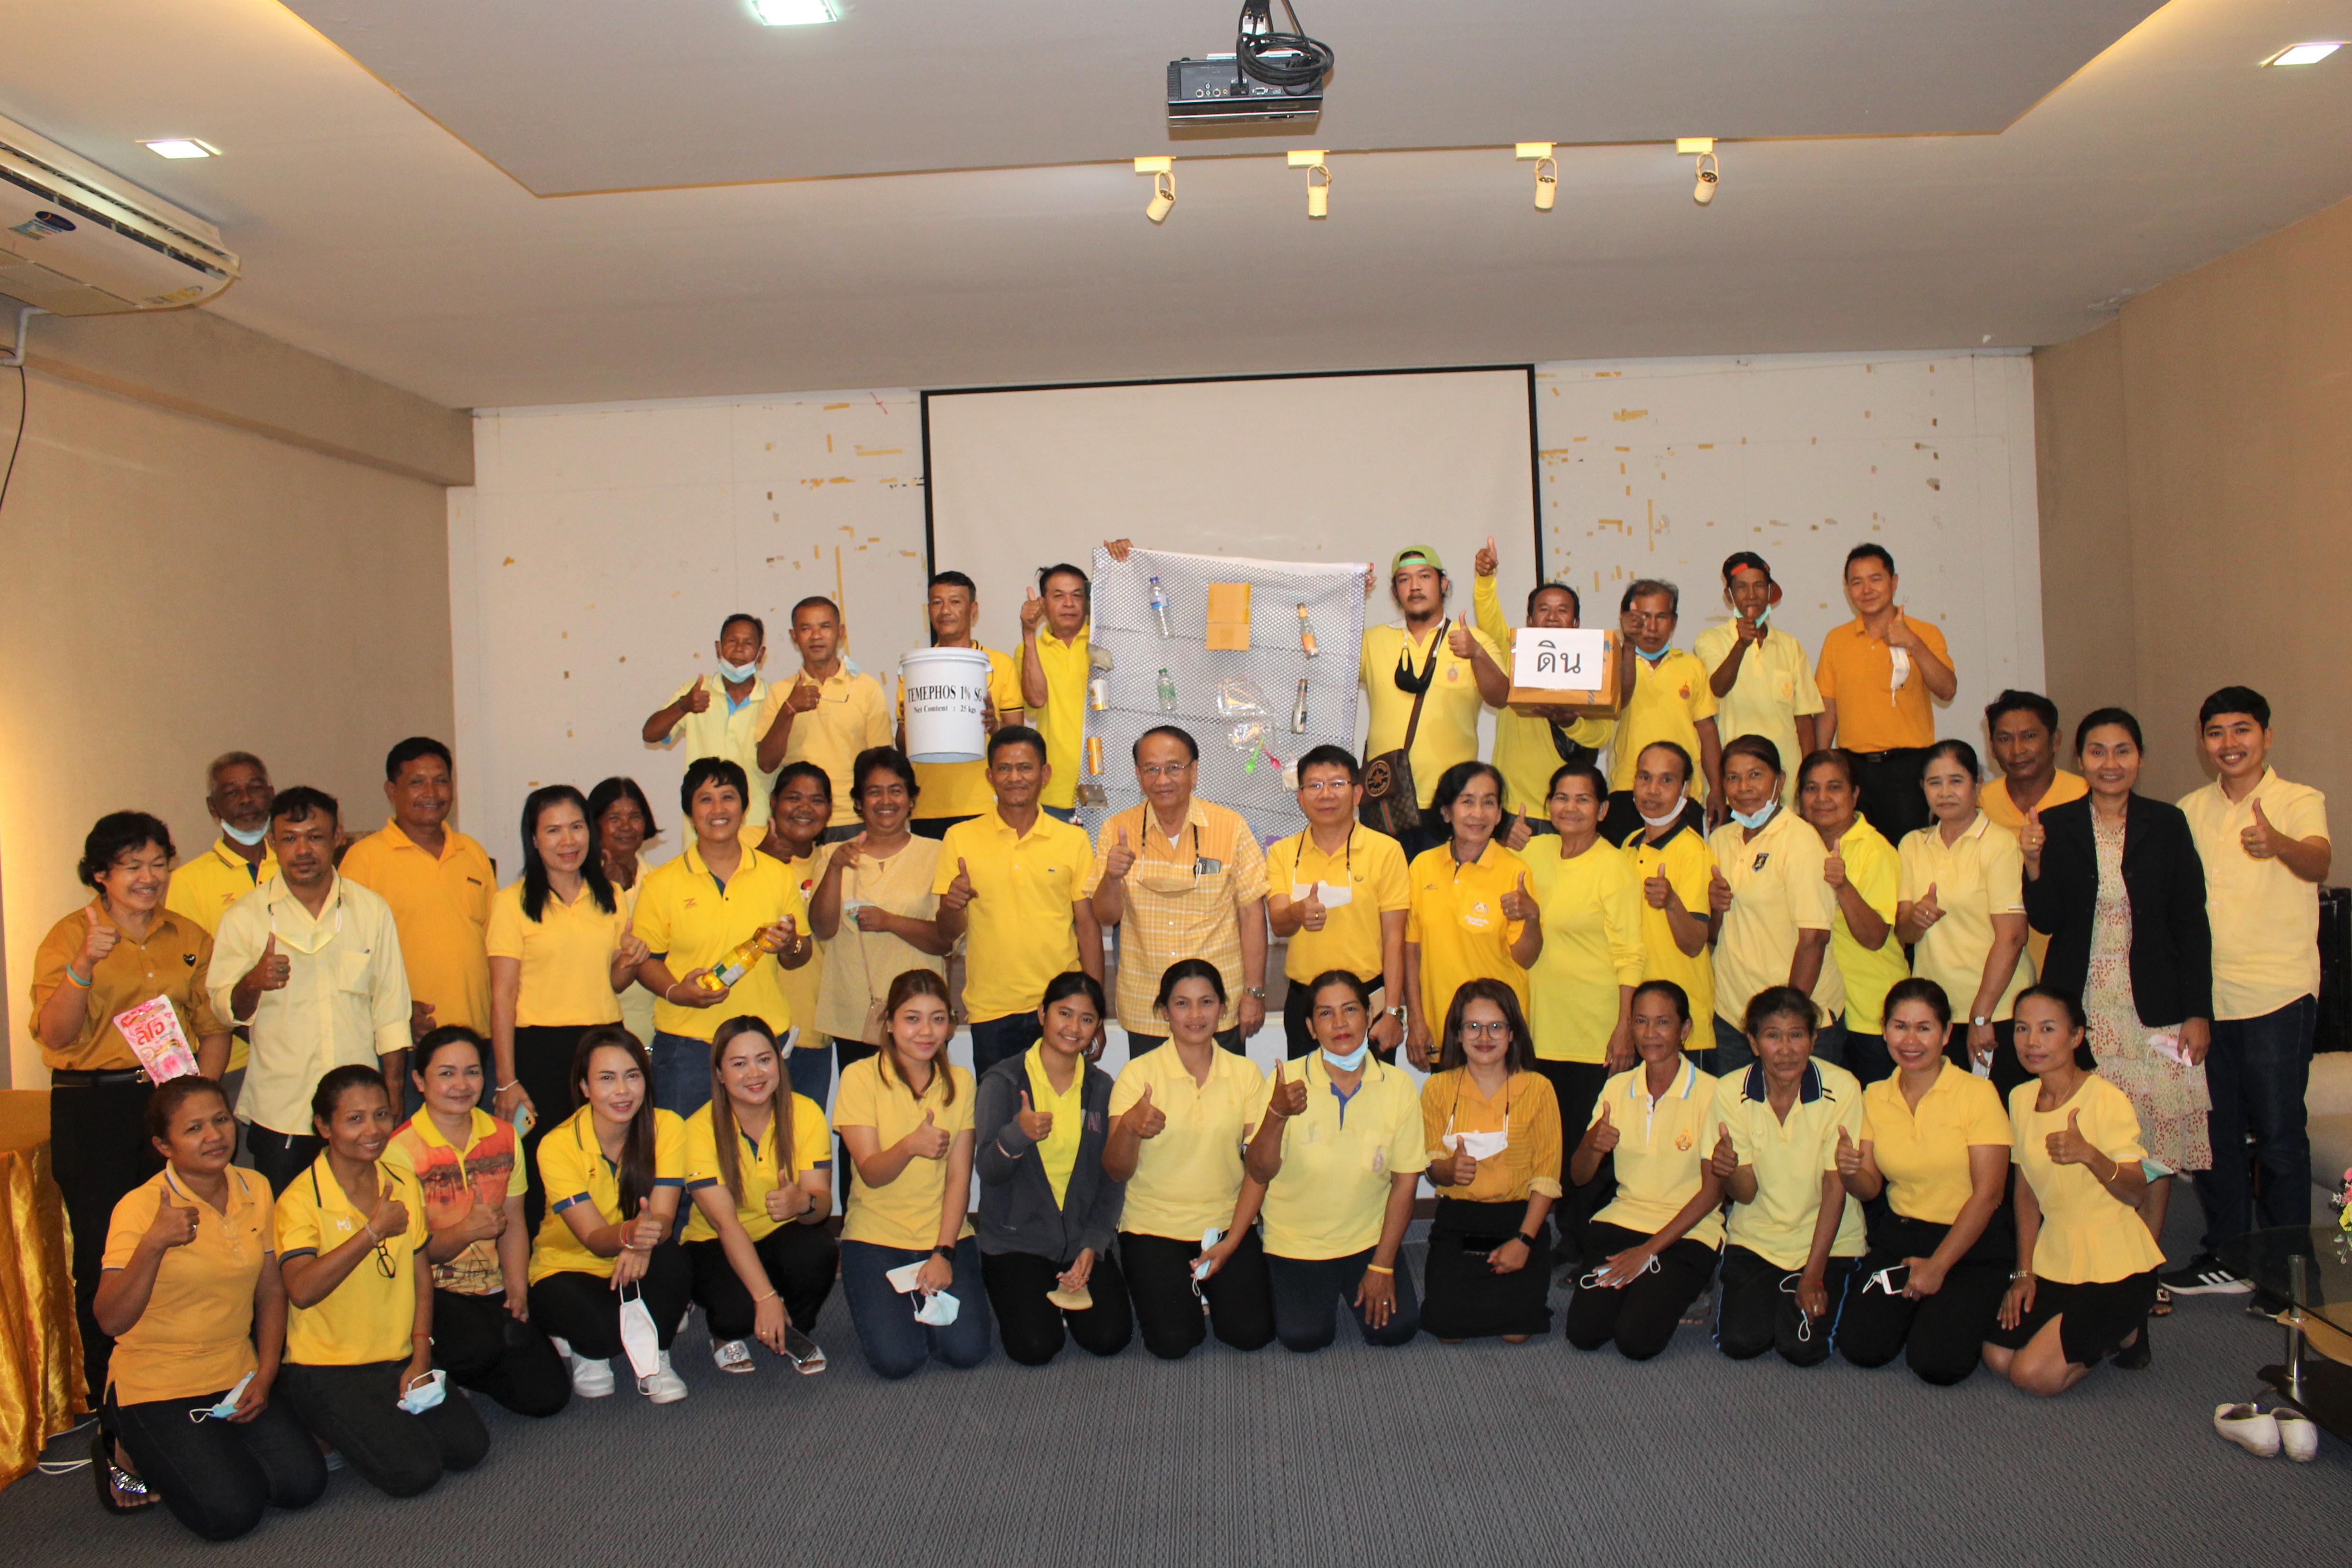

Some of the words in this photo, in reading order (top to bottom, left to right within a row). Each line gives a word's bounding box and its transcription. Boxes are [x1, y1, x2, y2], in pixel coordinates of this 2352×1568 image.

[1537, 640, 1581, 673] ดิน
[908, 685, 956, 702] TEMEPHOS
[960, 686, 971, 700] 1%
